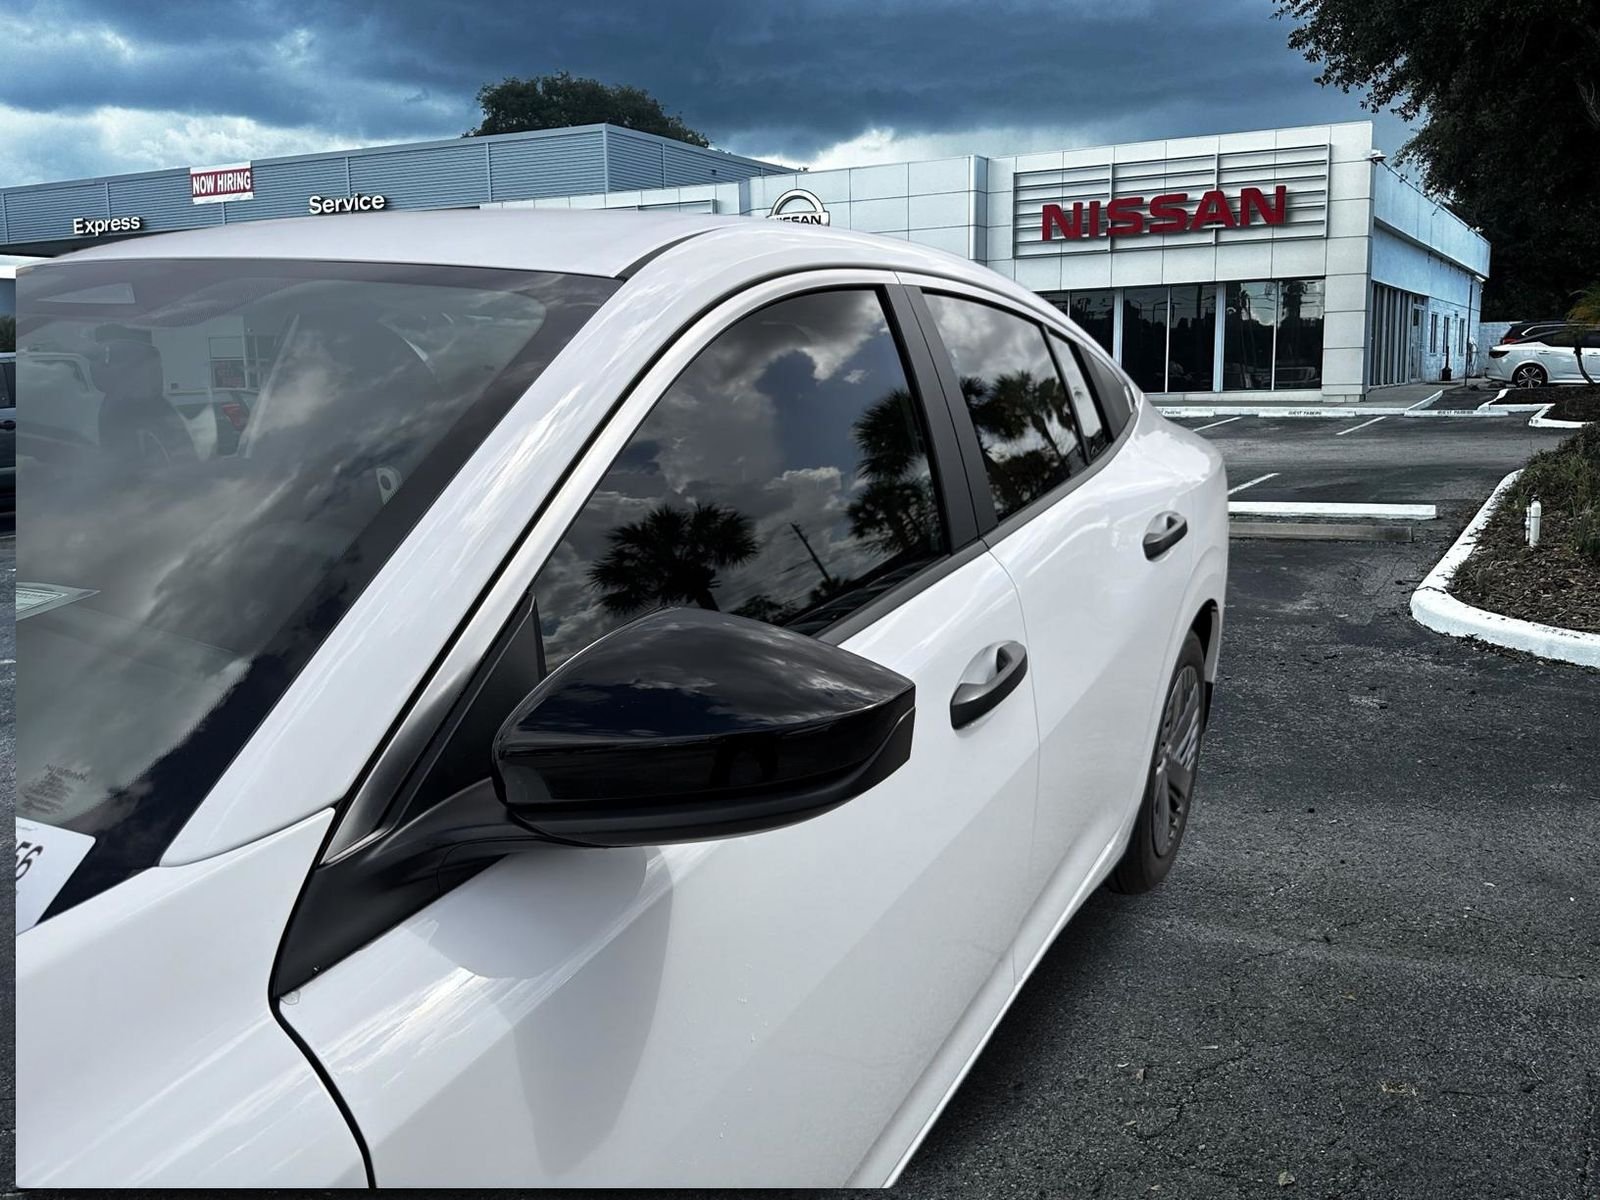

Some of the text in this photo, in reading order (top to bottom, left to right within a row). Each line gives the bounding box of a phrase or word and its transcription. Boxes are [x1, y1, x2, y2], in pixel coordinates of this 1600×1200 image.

[192, 171, 251, 195] NOW HIRING
[309, 193, 385, 214] Service
[1042, 185, 1287, 241] NISSAN
[73, 216, 141, 236] Express
